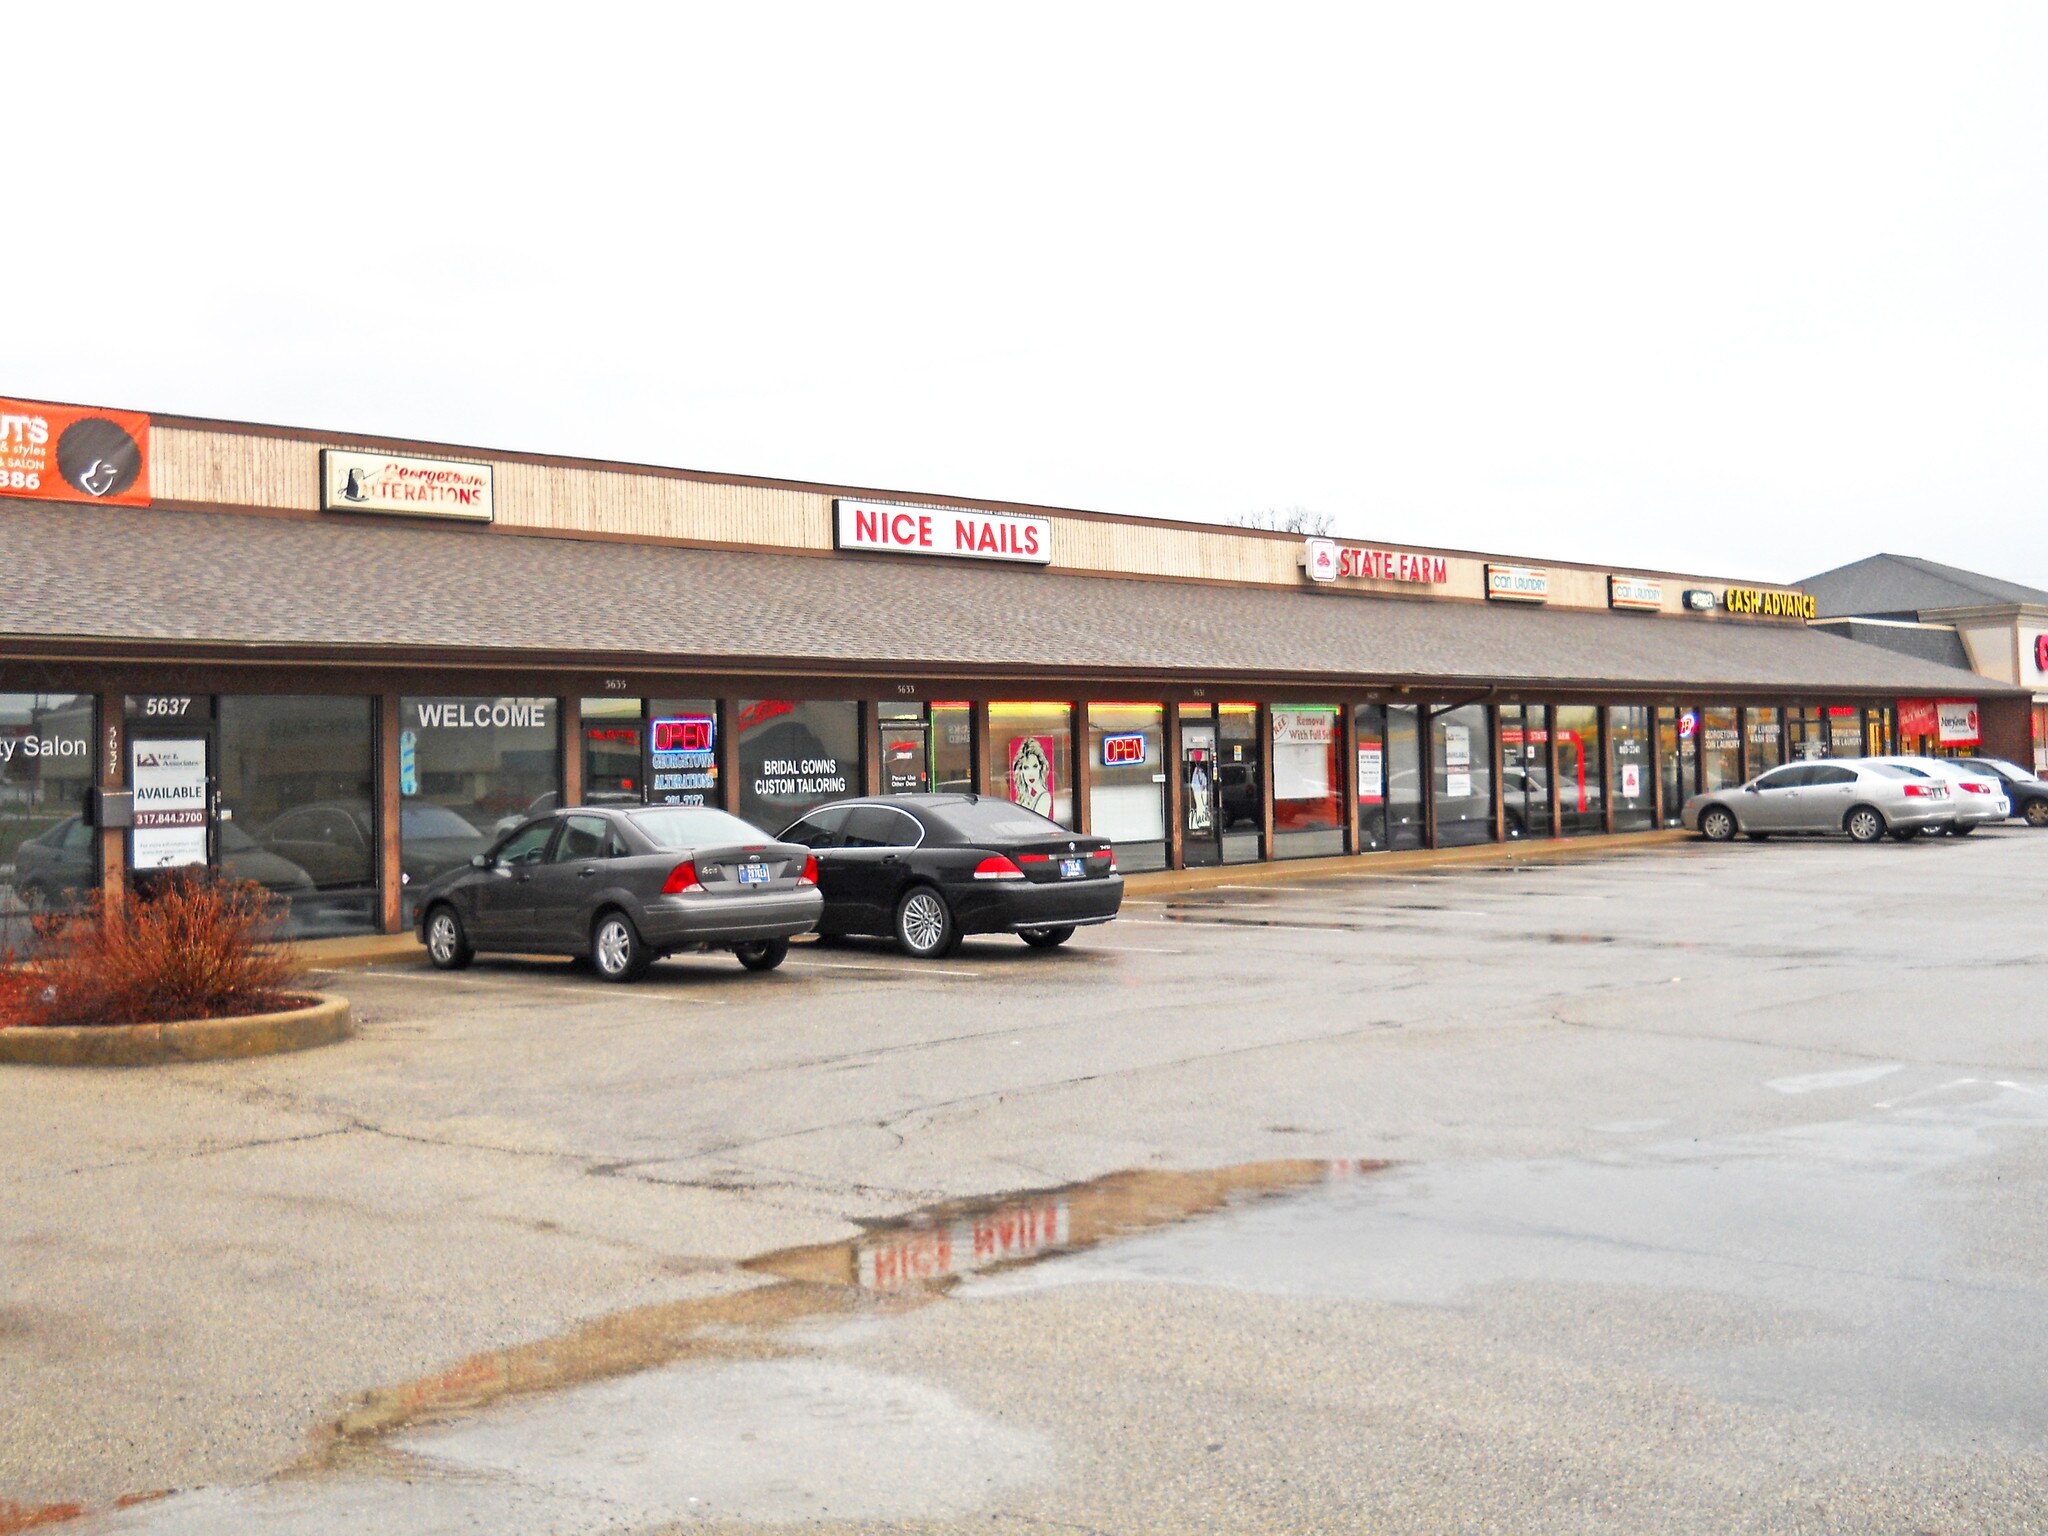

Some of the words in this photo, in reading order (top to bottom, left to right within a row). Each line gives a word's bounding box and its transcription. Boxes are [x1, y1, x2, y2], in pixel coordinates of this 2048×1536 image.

[13, 443, 46, 458] styles
[8, 458, 45, 470] SALON
[856, 509, 933, 547] NICE
[955, 519, 1039, 556] NAILS
[1340, 548, 1394, 580] STATE
[1400, 554, 1447, 583] FARM
[1726, 586, 1760, 614] CASH
[1763, 592, 1817, 620] ADVANCE
[146, 697, 191, 716] 5637
[418, 704, 546, 728] WELCOME
[1296, 715, 1326, 726] Removal
[656, 723, 711, 751] OPEN
[1289, 730, 1309, 740] With
[23, 734, 87, 757] Salon
[109, 726, 118, 775] 5637
[1107, 739, 1145, 762] OPEN
[764, 760, 800, 776] BRIDAL
[801, 759, 837, 775] GOWNS
[137, 786, 203, 800] AVAILABLE
[755, 779, 796, 796] CUSTOM
[797, 777, 846, 793] TAILORING
[136, 812, 203, 825] 317.844.2700
